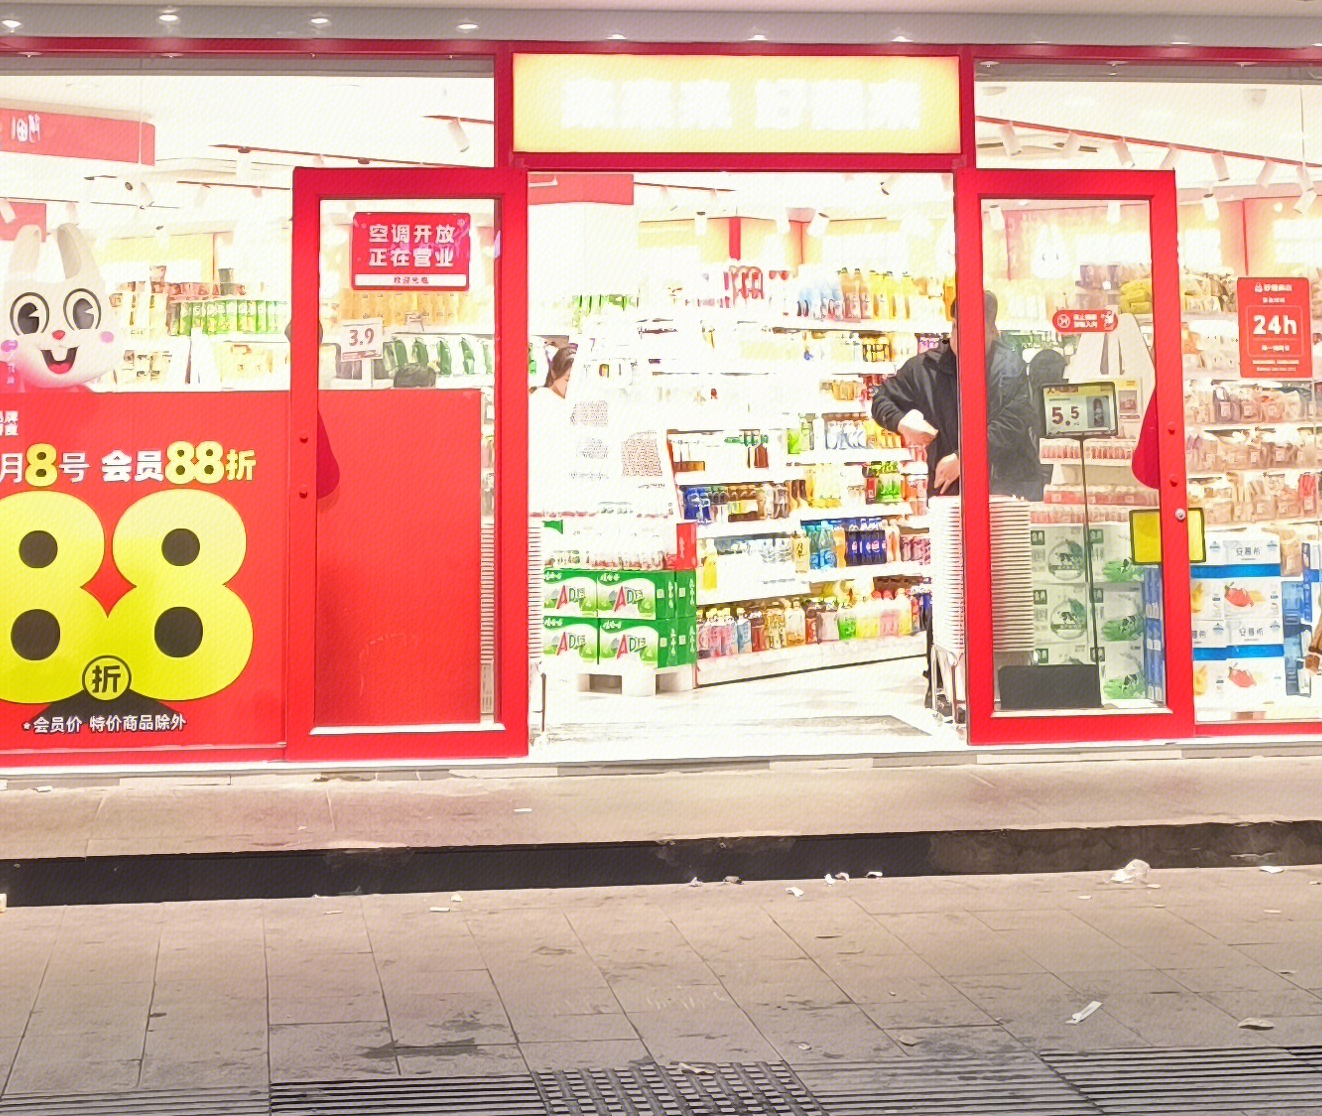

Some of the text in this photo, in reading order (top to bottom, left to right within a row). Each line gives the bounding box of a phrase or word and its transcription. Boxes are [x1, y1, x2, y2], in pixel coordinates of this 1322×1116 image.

[368, 224, 456, 244] 空调开放
[368, 247, 455, 268] 正在营业
[1252, 314, 1297, 335] 24h
[349, 327, 375, 347] 3.9
[1051, 405, 1081, 426] 5.5
[101, 440, 257, 486] 会员88折
[91, 664, 122, 694] 折
[33, 713, 186, 734] 会员价 特价商品除外
